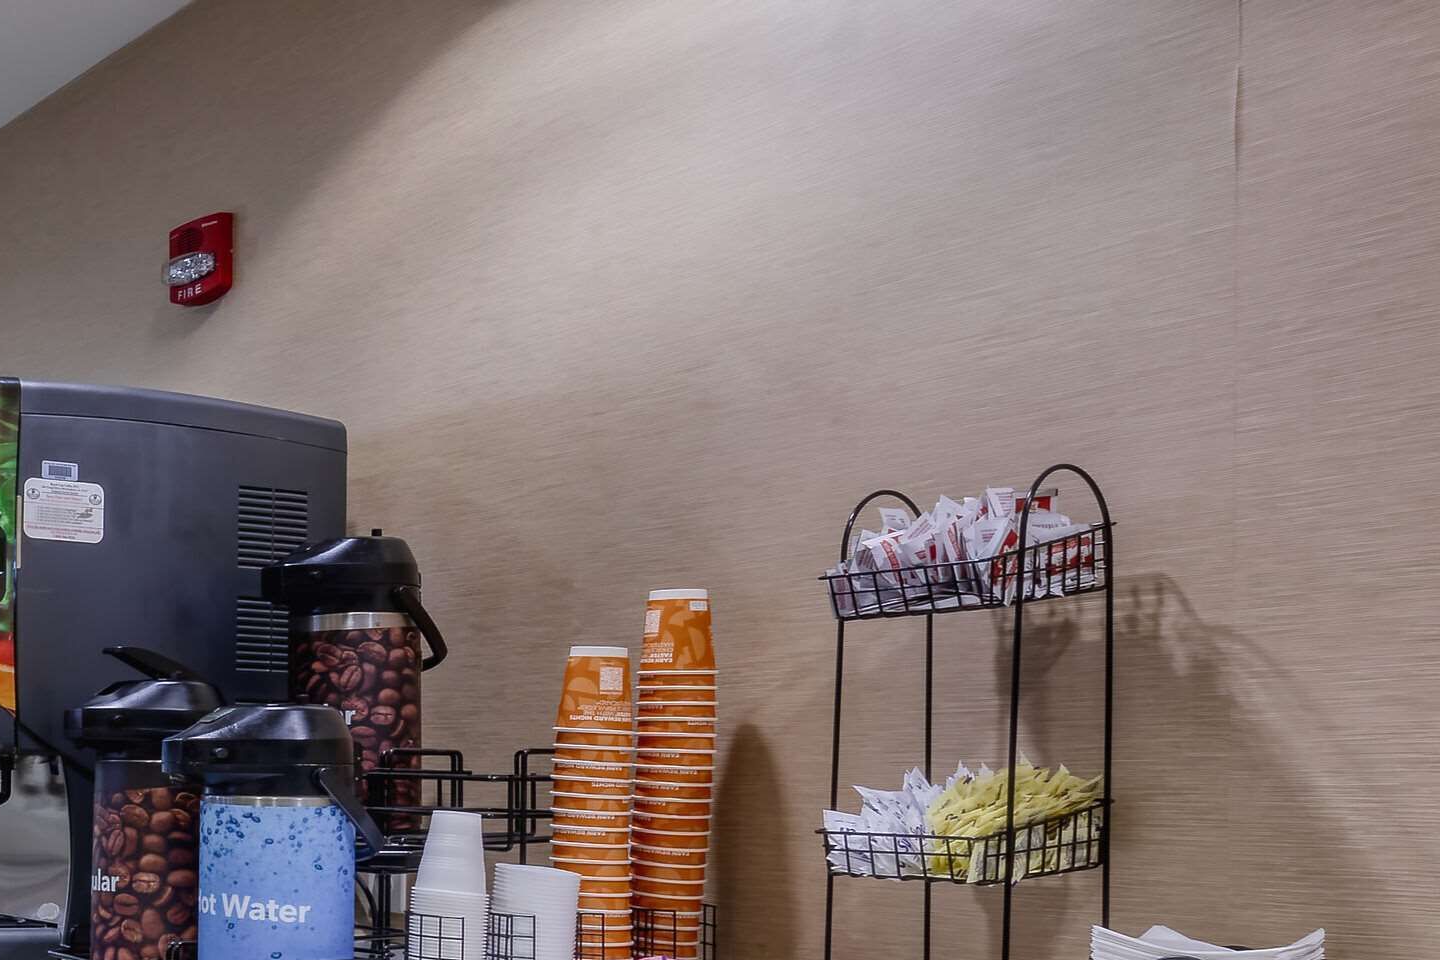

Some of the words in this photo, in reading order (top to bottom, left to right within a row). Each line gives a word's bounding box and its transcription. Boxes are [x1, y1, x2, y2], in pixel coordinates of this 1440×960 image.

[177, 283, 202, 300] FIRE
[91, 867, 120, 892] ular
[221, 893, 311, 924] Water
